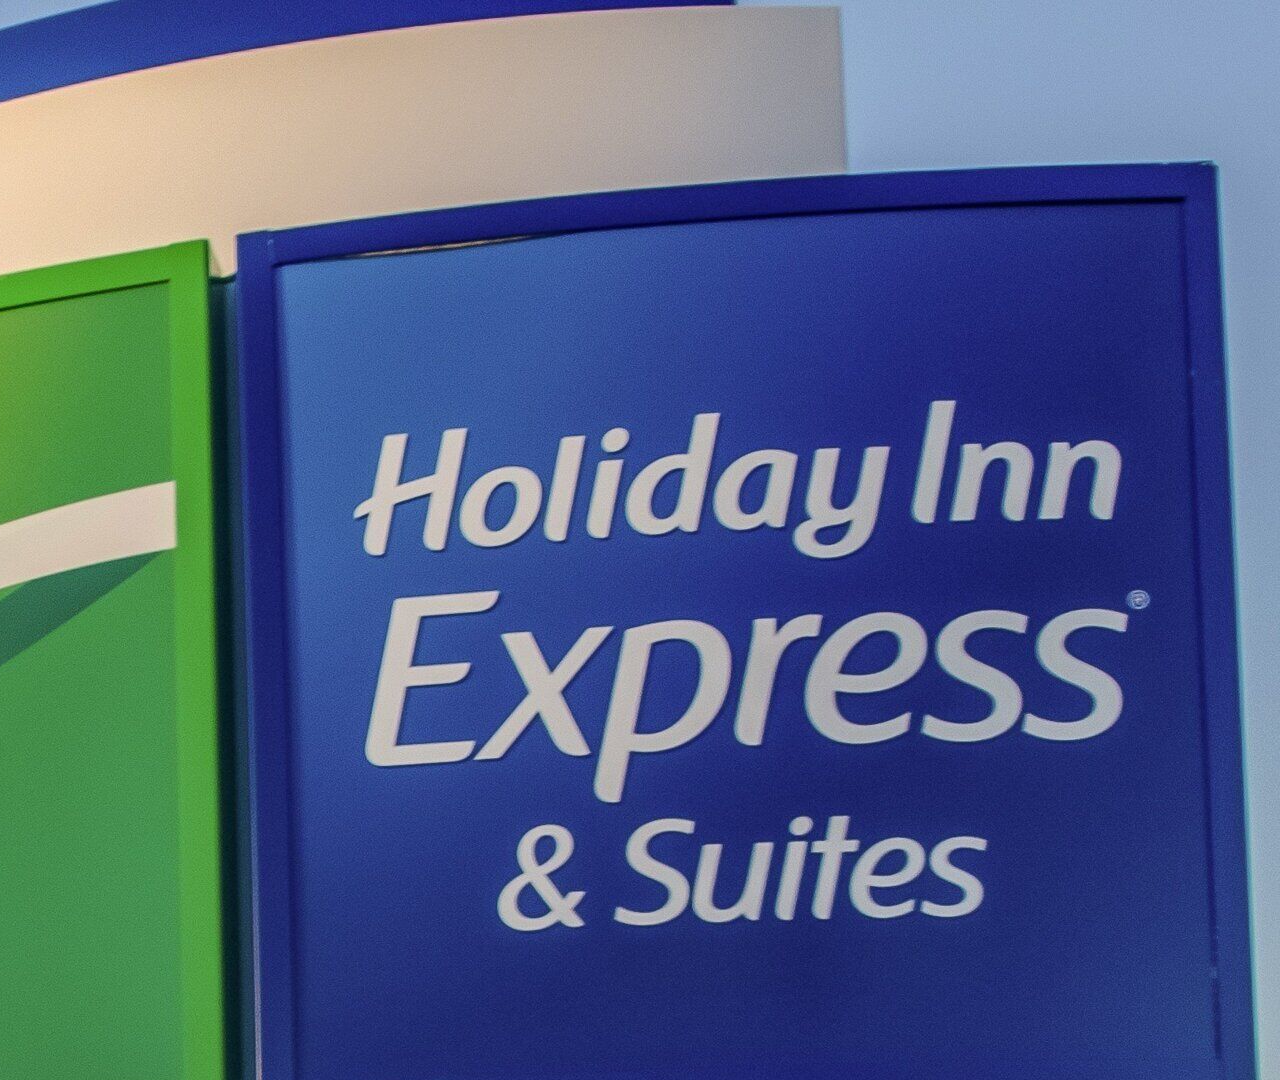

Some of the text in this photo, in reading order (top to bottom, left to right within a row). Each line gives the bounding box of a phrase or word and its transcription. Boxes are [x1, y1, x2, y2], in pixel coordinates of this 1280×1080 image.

[352, 400, 1122, 559] Holiday Inn
[496, 815, 988, 932] & Suites
